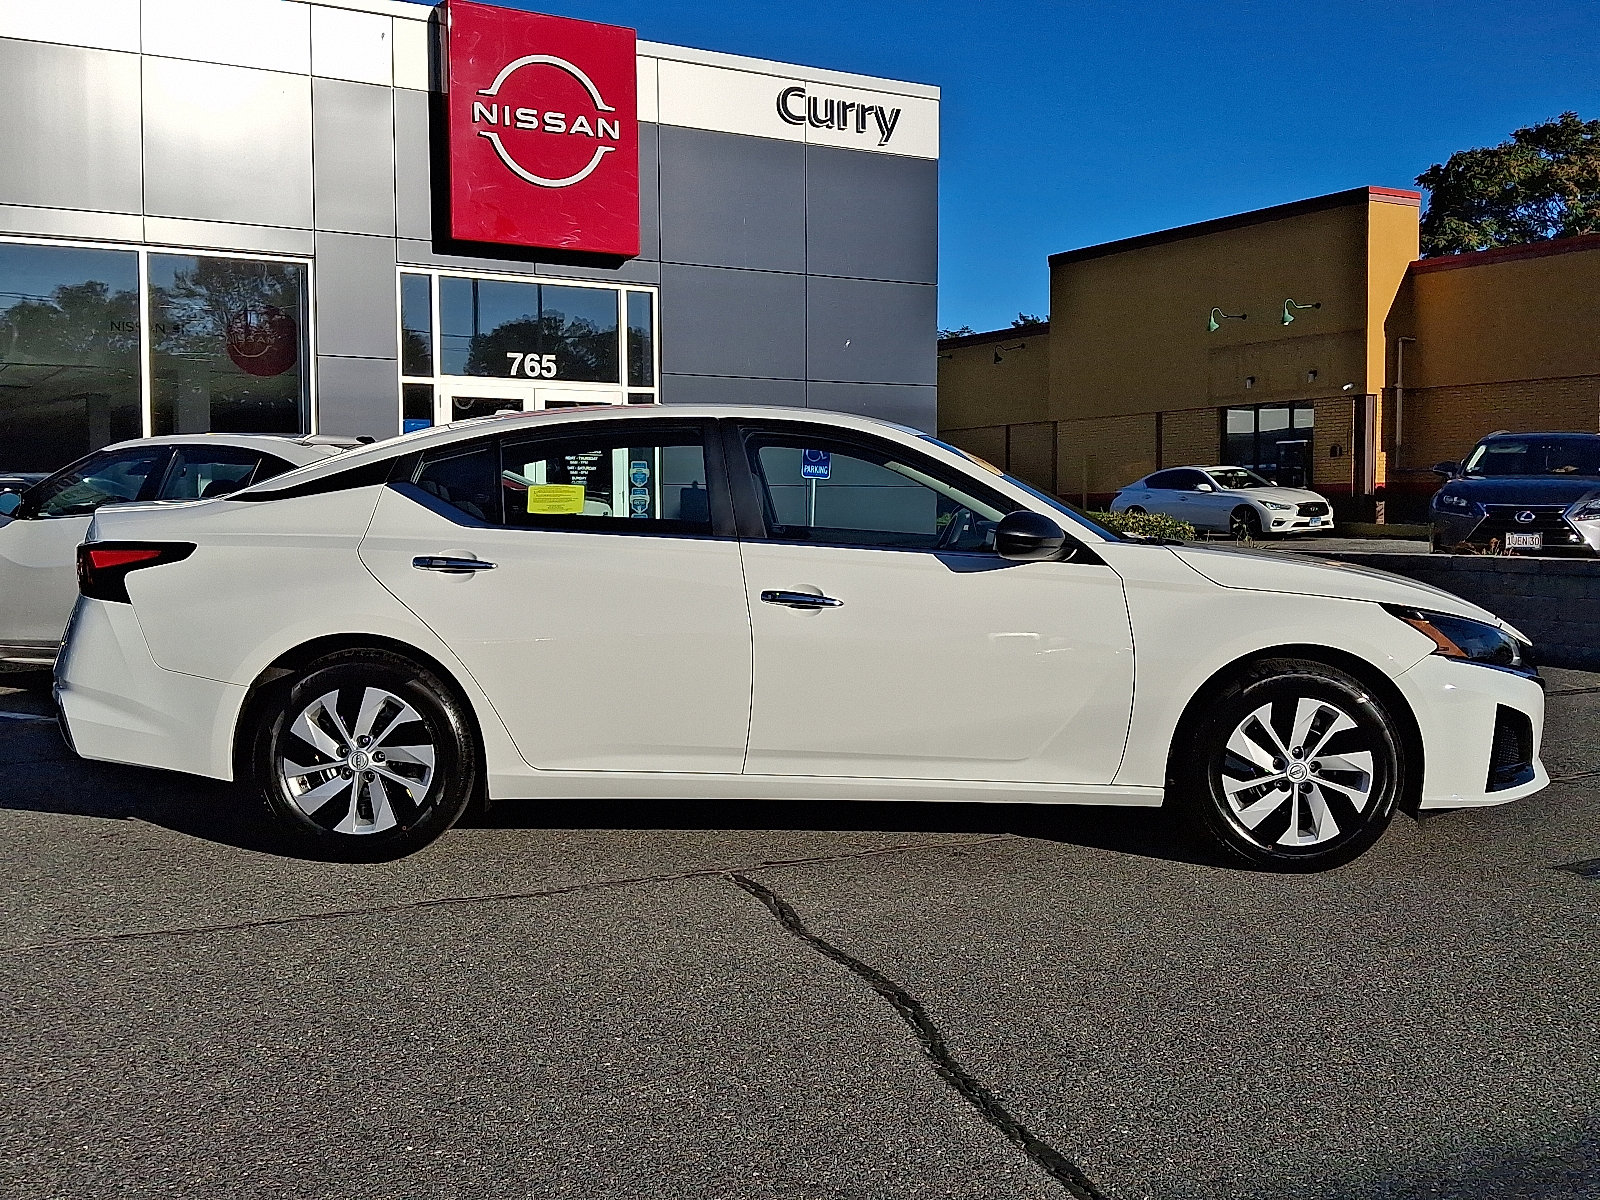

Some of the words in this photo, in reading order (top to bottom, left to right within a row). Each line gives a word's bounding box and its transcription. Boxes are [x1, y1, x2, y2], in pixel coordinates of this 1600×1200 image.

[472, 101, 620, 140] NISSAN
[776, 86, 901, 146] Curry
[110, 321, 166, 334] NISN
[506, 352, 557, 378] 765
[804, 464, 828, 474] PARKING
[1530, 536, 1540, 545] 30
